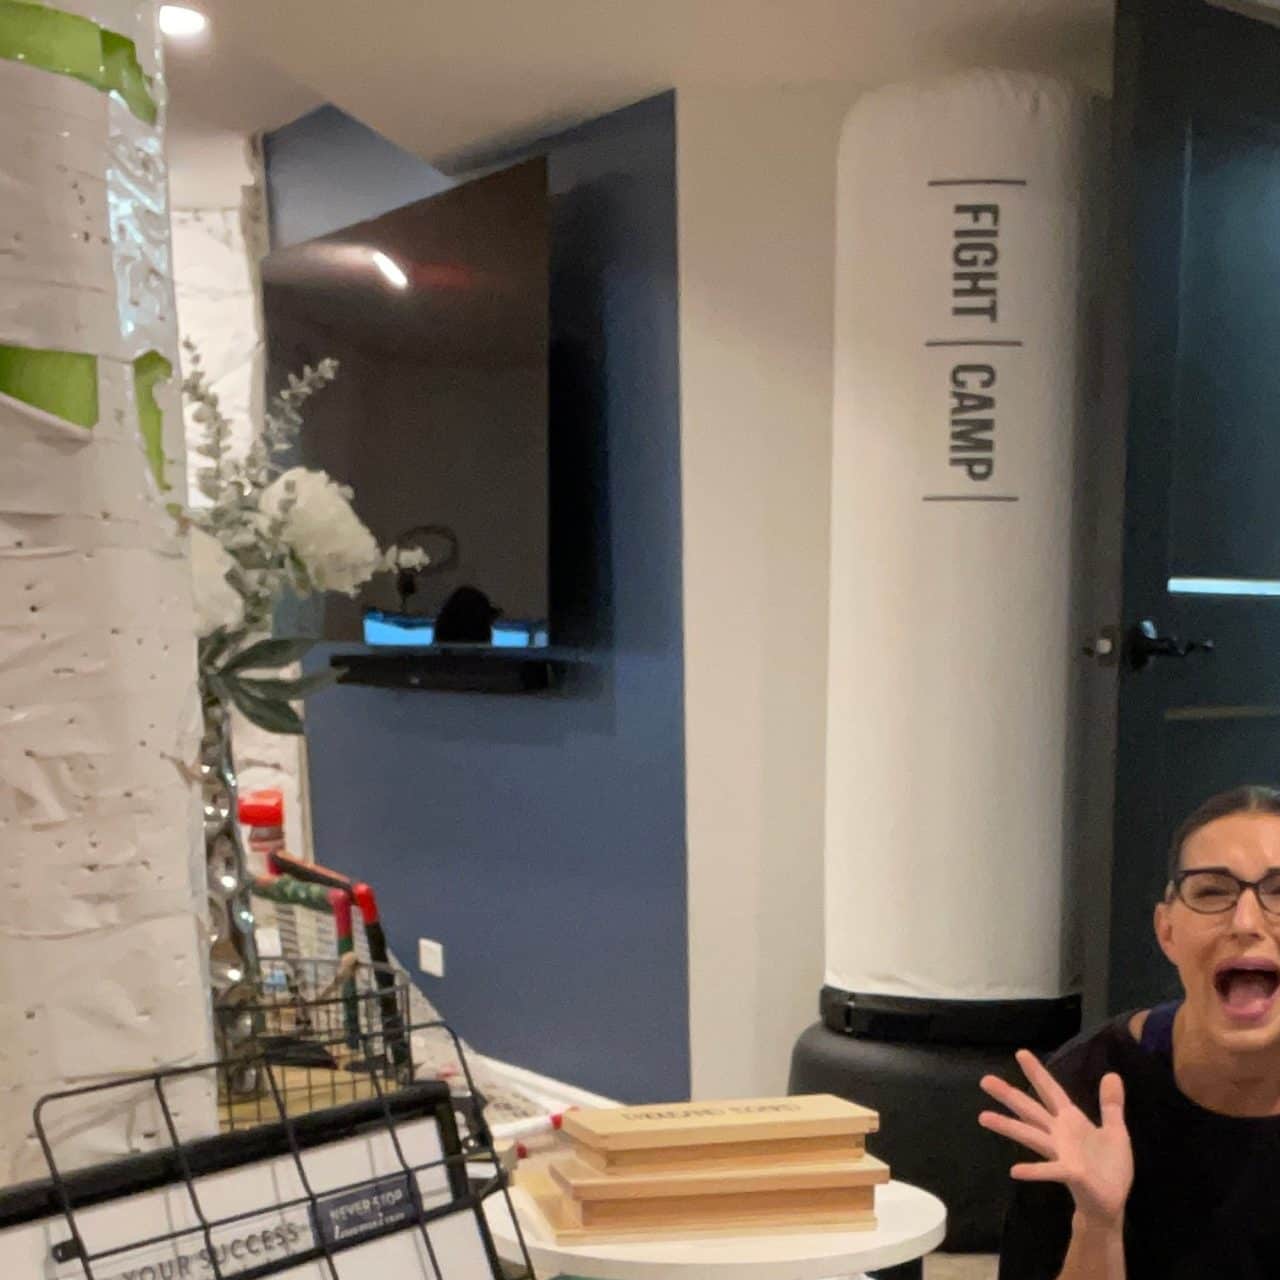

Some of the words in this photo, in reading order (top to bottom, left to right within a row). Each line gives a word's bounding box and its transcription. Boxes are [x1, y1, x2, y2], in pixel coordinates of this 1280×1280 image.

[951, 203, 1000, 323] FIGHT
[948, 363, 996, 482] CAMP
[199, 1221, 300, 1270] SUCCESS
